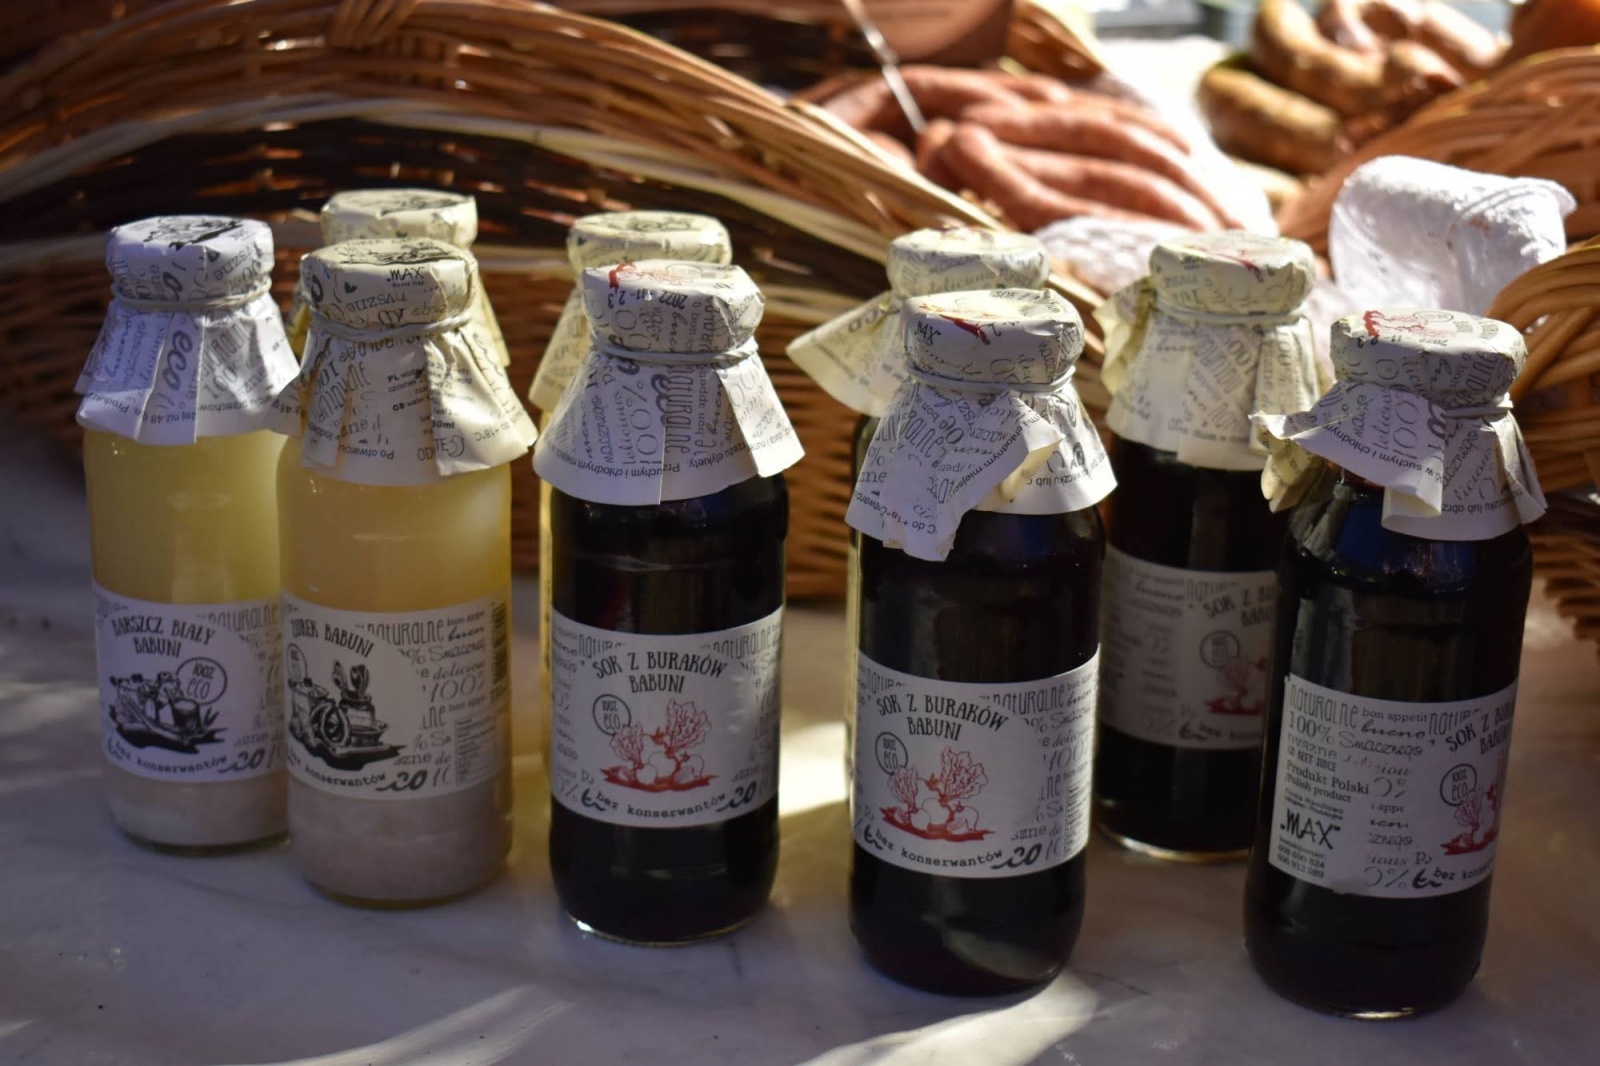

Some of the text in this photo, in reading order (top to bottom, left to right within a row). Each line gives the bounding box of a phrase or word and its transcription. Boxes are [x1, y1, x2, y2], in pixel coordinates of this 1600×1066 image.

[133, 637, 183, 658] BABUNI
[324, 622, 375, 658] BABUNI
[592, 655, 623, 680] SOK
[627, 651, 640, 671] Z
[646, 650, 728, 680] BURAKÓW
[628, 673, 685, 694] BABUNI
[876, 693, 1010, 733] SOK Z BURAKÓW
[1289, 710, 1335, 745] 100%
[906, 716, 962, 742] BABUNI
[1445, 723, 1477, 752] SOK
[1286, 759, 1370, 796] Produkt Polski
